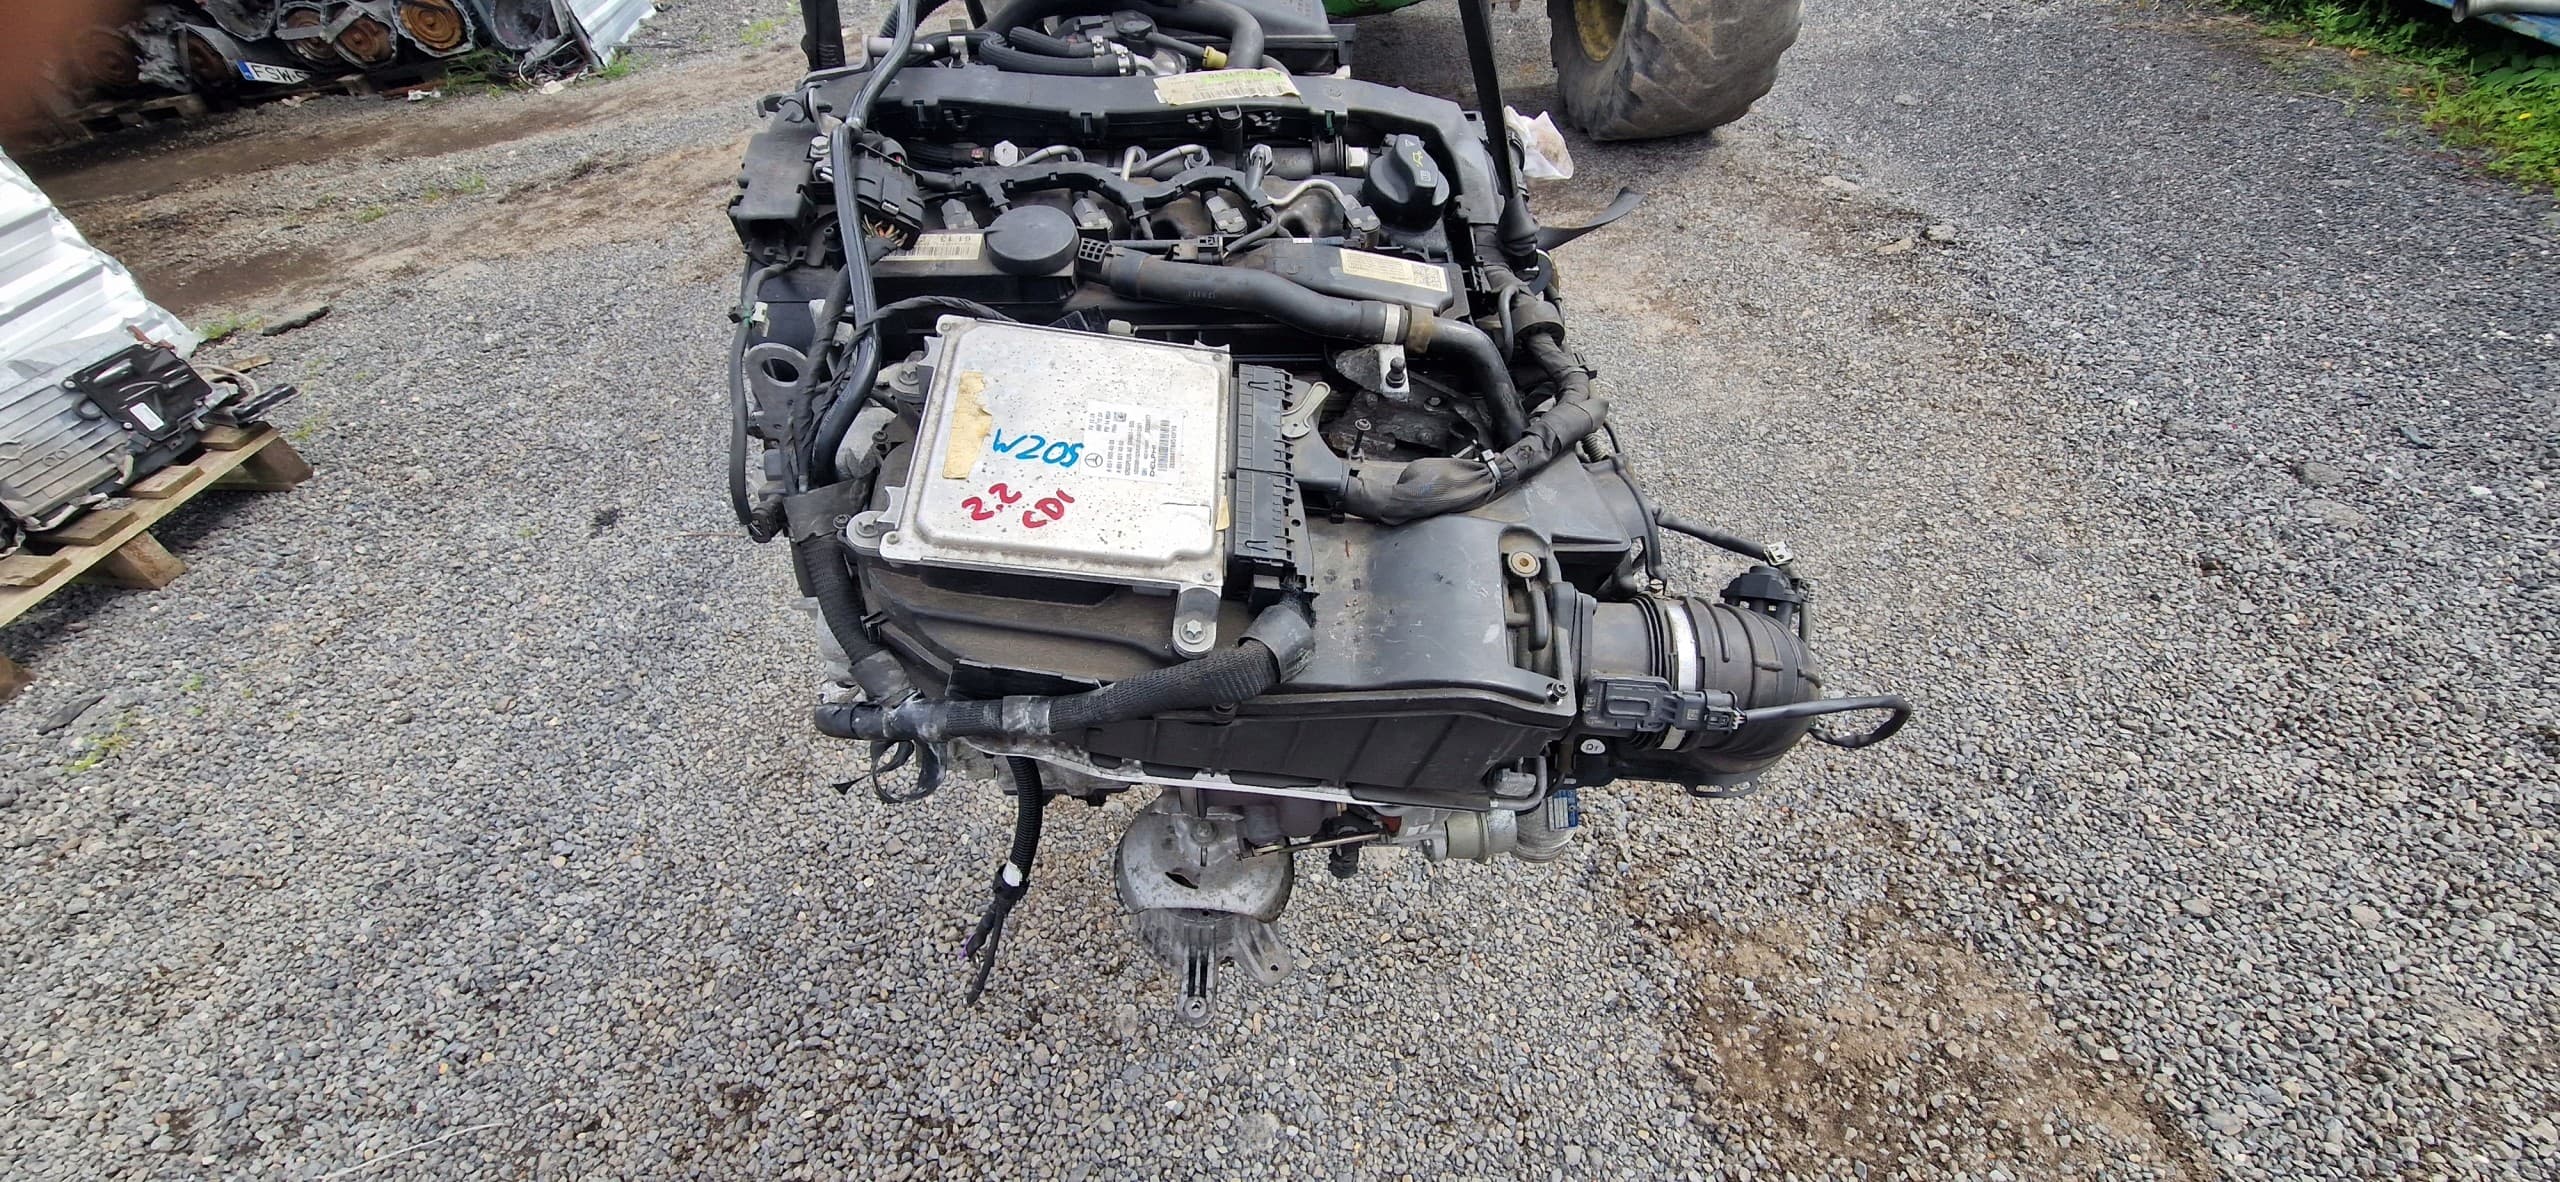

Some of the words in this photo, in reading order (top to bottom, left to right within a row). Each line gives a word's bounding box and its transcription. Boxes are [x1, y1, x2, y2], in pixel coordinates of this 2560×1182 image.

[251, 65, 294, 82] FSW
[993, 428, 1084, 467] W205
[1149, 445, 1157, 477] DELPHI
[961, 483, 1022, 520] 2.2
